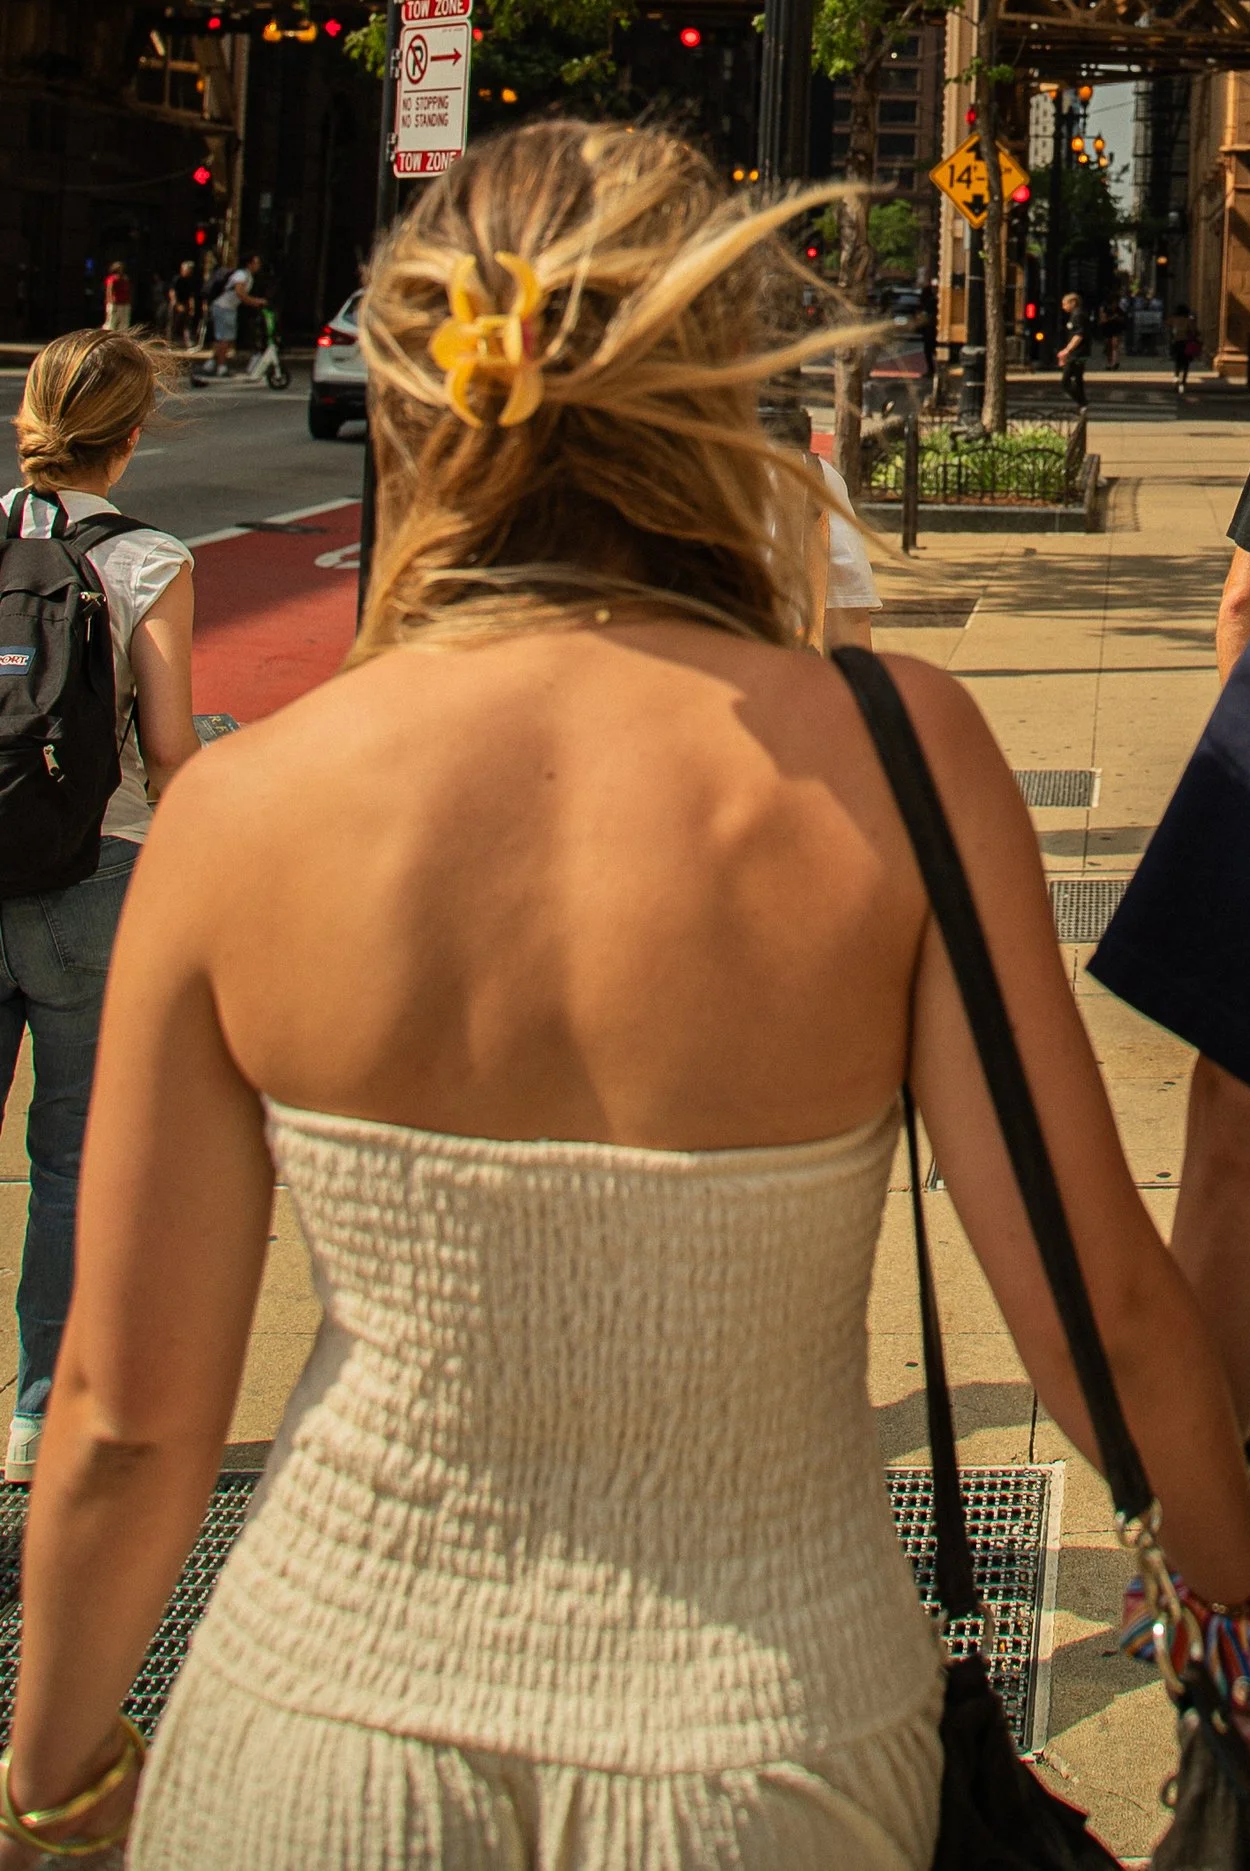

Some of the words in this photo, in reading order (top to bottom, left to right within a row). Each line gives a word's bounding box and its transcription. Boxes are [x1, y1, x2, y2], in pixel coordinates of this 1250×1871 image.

[407, 0, 430, 19] TOW
[402, 97, 412, 111] NO
[415, 95, 449, 110] STOPPING
[402, 114, 412, 128] NO
[415, 113, 449, 127] STANDING
[399, 152, 422, 172] TOW
